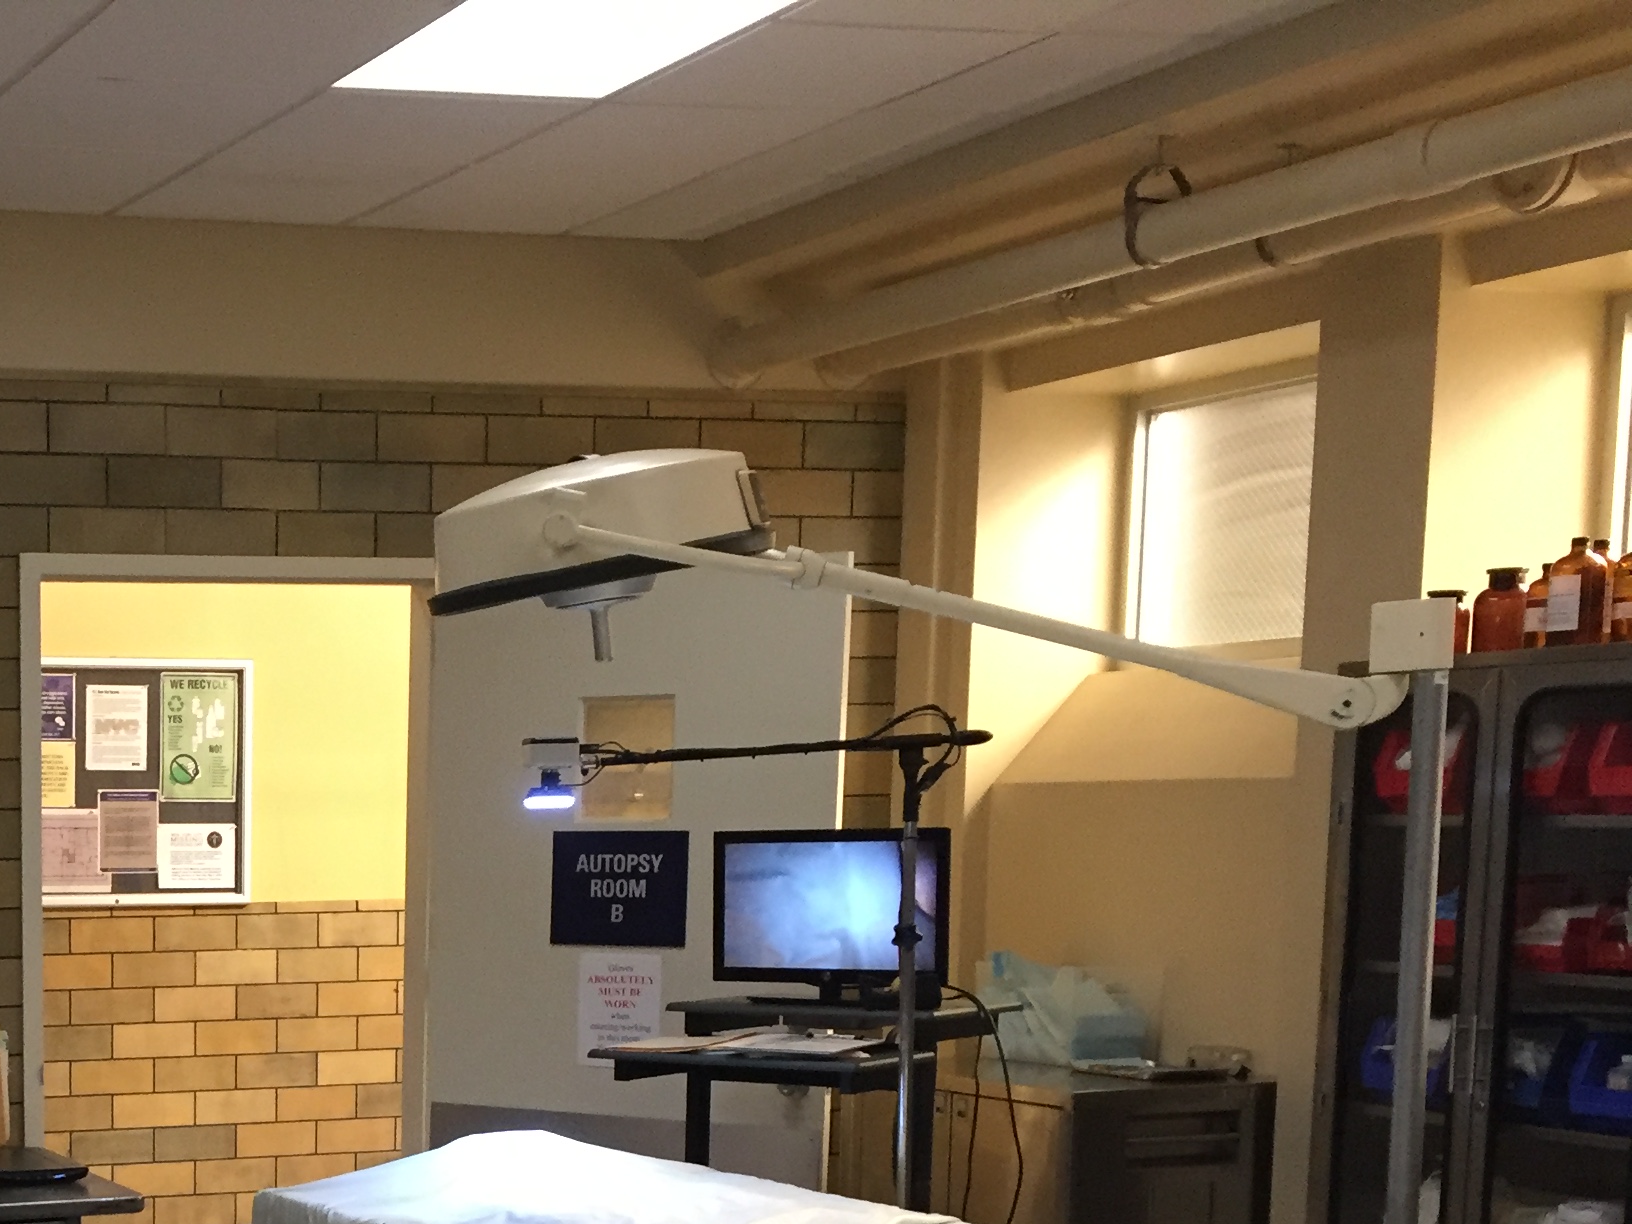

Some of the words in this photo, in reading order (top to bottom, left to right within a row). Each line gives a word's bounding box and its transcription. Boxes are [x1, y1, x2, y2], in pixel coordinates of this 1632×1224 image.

[170, 679, 184, 689] WE
[187, 679, 228, 690] RECYCLE
[168, 714, 183, 723] YES
[575, 853, 663, 873] AUTOPSY
[590, 879, 647, 898] ROOM
[610, 903, 624, 922] B
[608, 964, 633, 972] Gloves
[587, 975, 654, 985] ABSOLUTELY
[598, 987, 626, 996] MUST
[629, 988, 641, 996] BE
[604, 999, 636, 1009] WORN
